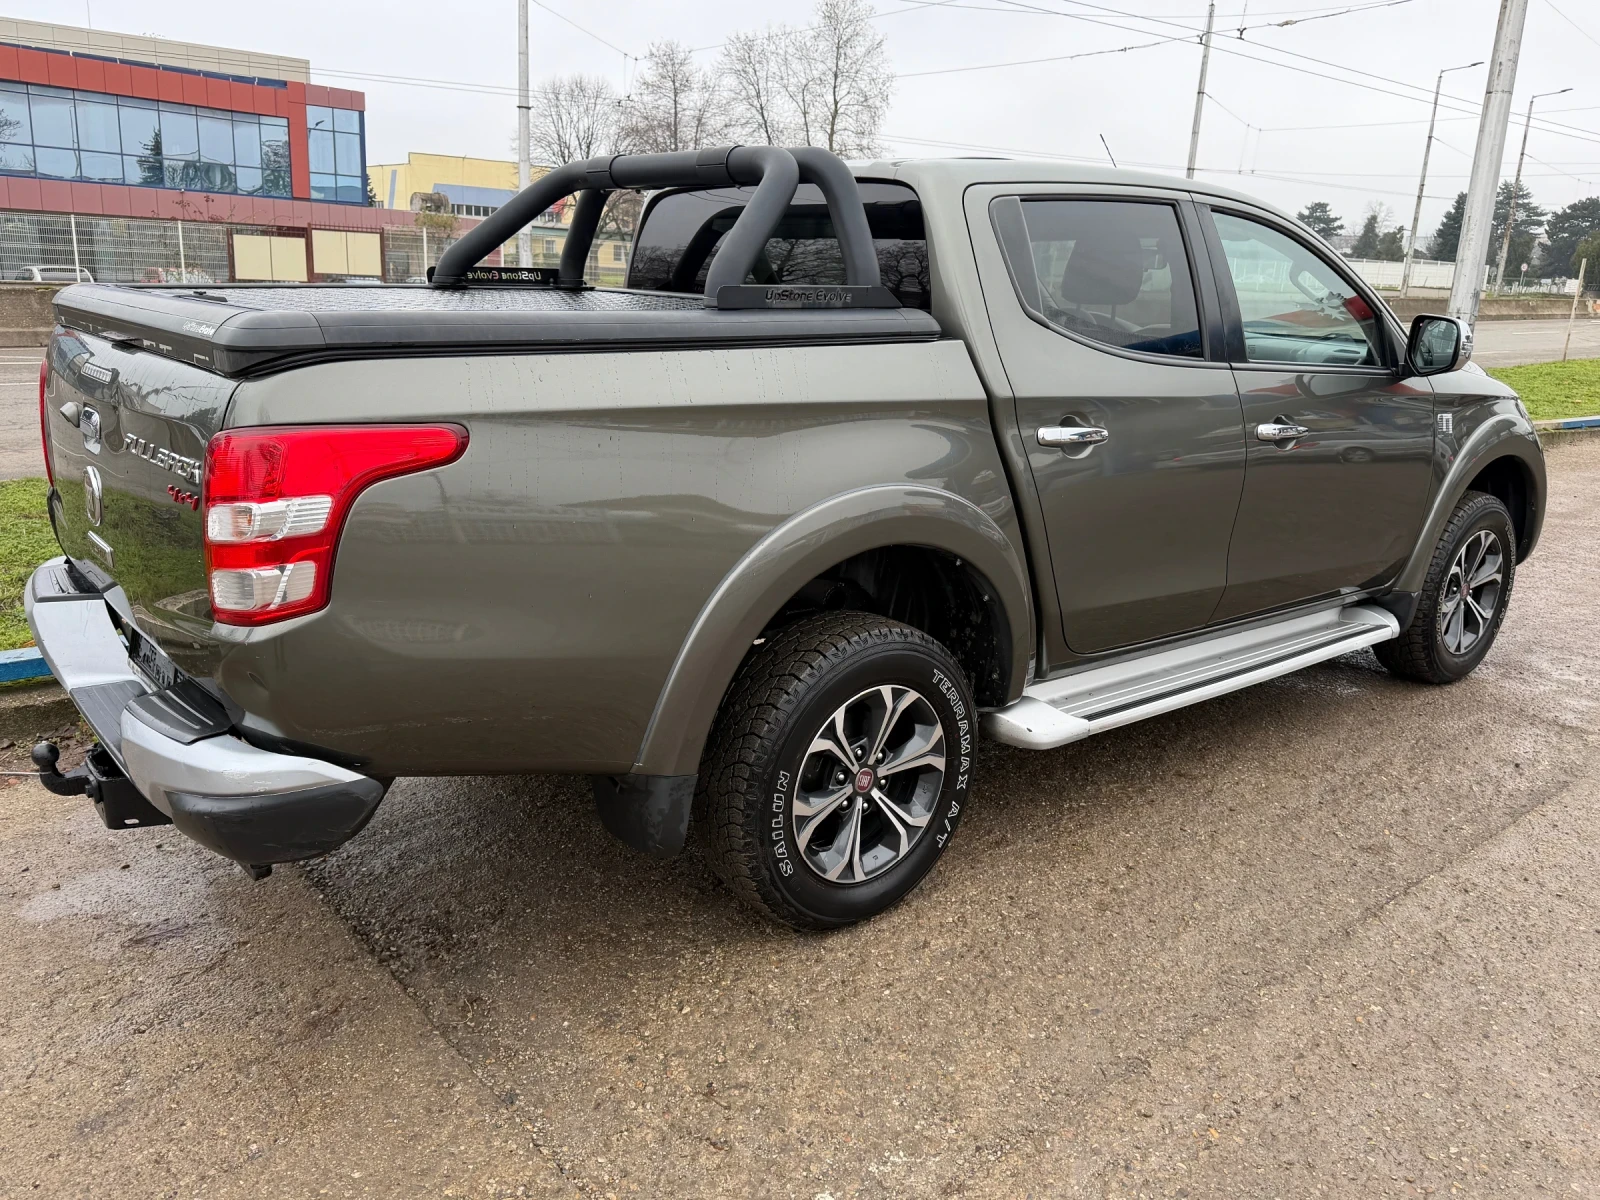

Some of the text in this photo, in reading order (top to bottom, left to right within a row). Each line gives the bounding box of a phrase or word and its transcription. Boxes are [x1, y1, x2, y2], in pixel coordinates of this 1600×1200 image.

[765, 288, 852, 304] UpStone Evolve
[932, 667, 971, 848] TERRAMAX A/T
[771, 770, 794, 877] SAILUN
